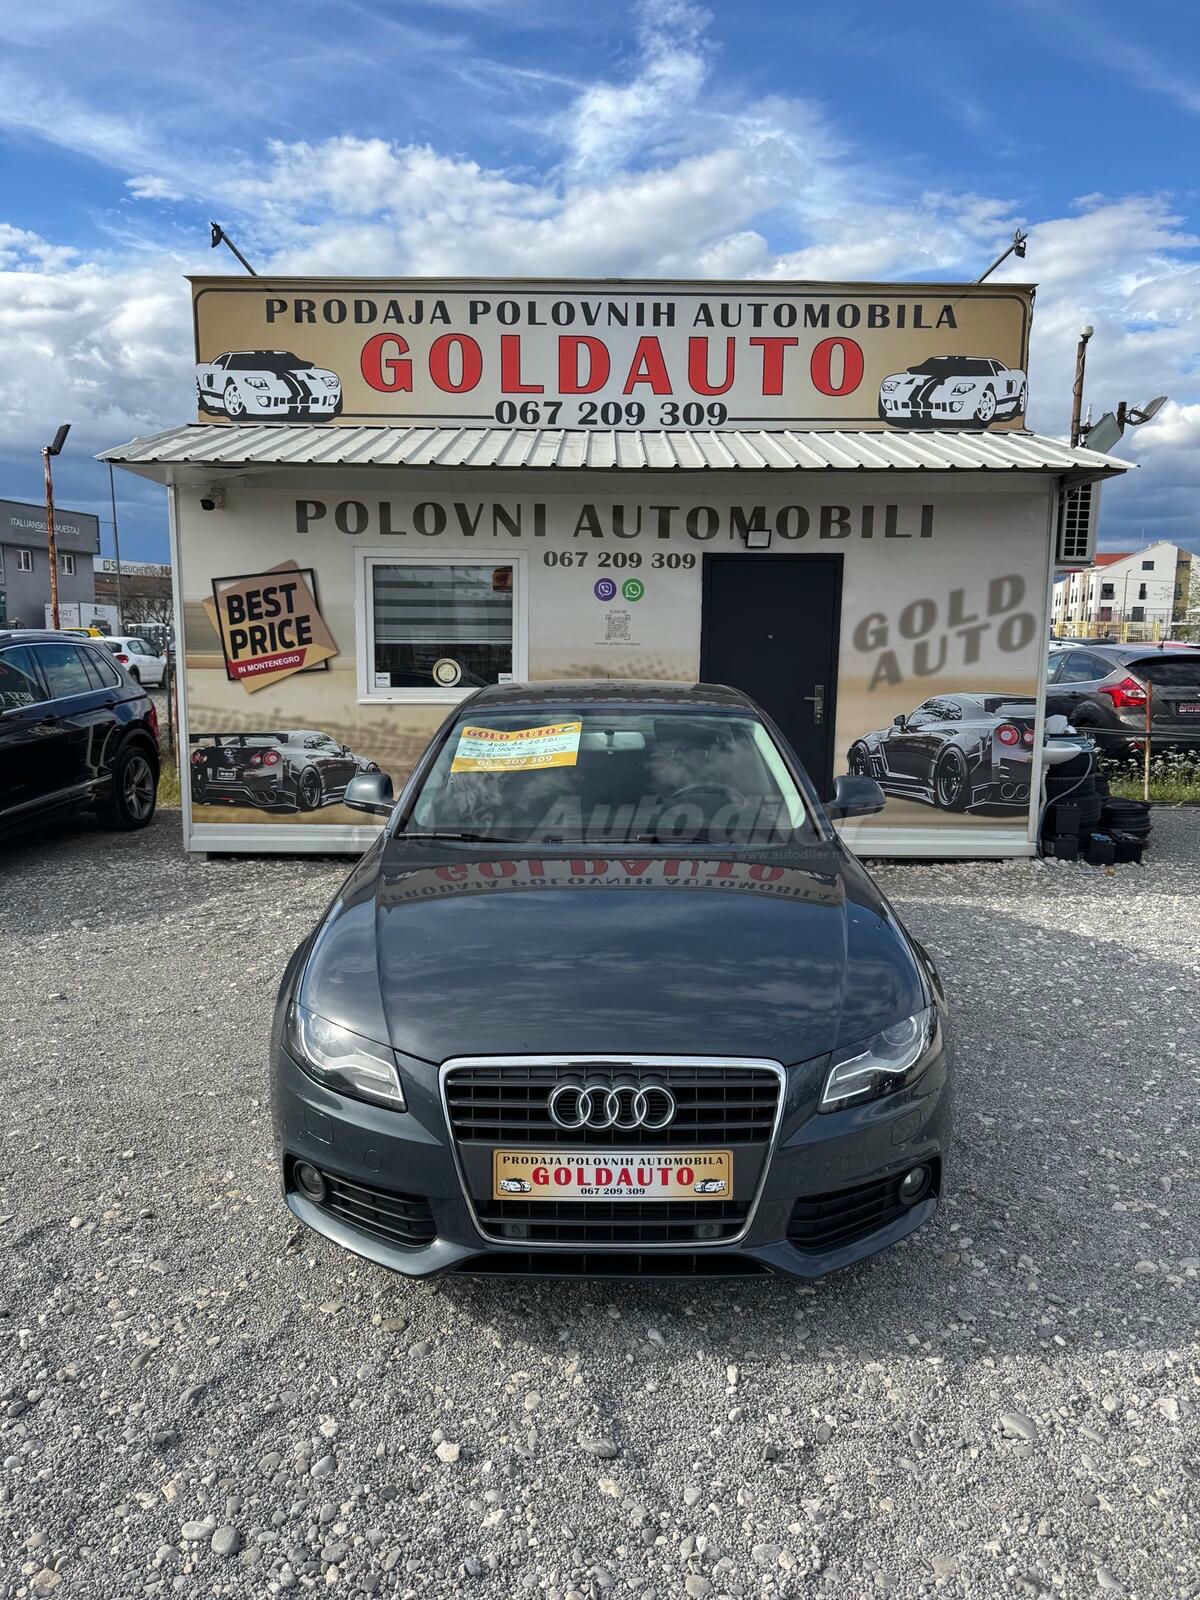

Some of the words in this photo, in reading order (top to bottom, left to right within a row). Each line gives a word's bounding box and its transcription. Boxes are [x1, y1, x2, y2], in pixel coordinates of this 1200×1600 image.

[266, 299, 452, 325] PRODAJA
[469, 300, 675, 327] POLOVNIH
[693, 303, 958, 329] AUTOMOBILA
[360, 332, 864, 396] GOLDAUTO
[494, 401, 563, 425] 067
[578, 401, 645, 426] 209
[659, 402, 727, 426] 309
[295, 500, 547, 537] POLOVNI
[573, 503, 934, 540] AUTOMOBILI
[543, 550, 587, 567] 067
[597, 551, 642, 568] 209
[651, 552, 696, 570] 309
[226, 582, 298, 626] BEST
[853, 573, 1026, 654] GOLD
[230, 614, 313, 659] PRICE
[867, 611, 1036, 692] AUTO
[247, 655, 300, 672] MONTENEGRO
[466, 730, 509, 740] GOLD
[516, 728, 556, 739] AUTO
[503, 1156, 562, 1165] PRODAJA
[567, 1157, 634, 1166] POLOVNIH
[638, 1156, 723, 1166] AUTOMOBILA
[532, 1166, 695, 1187] GOLDAUTO
